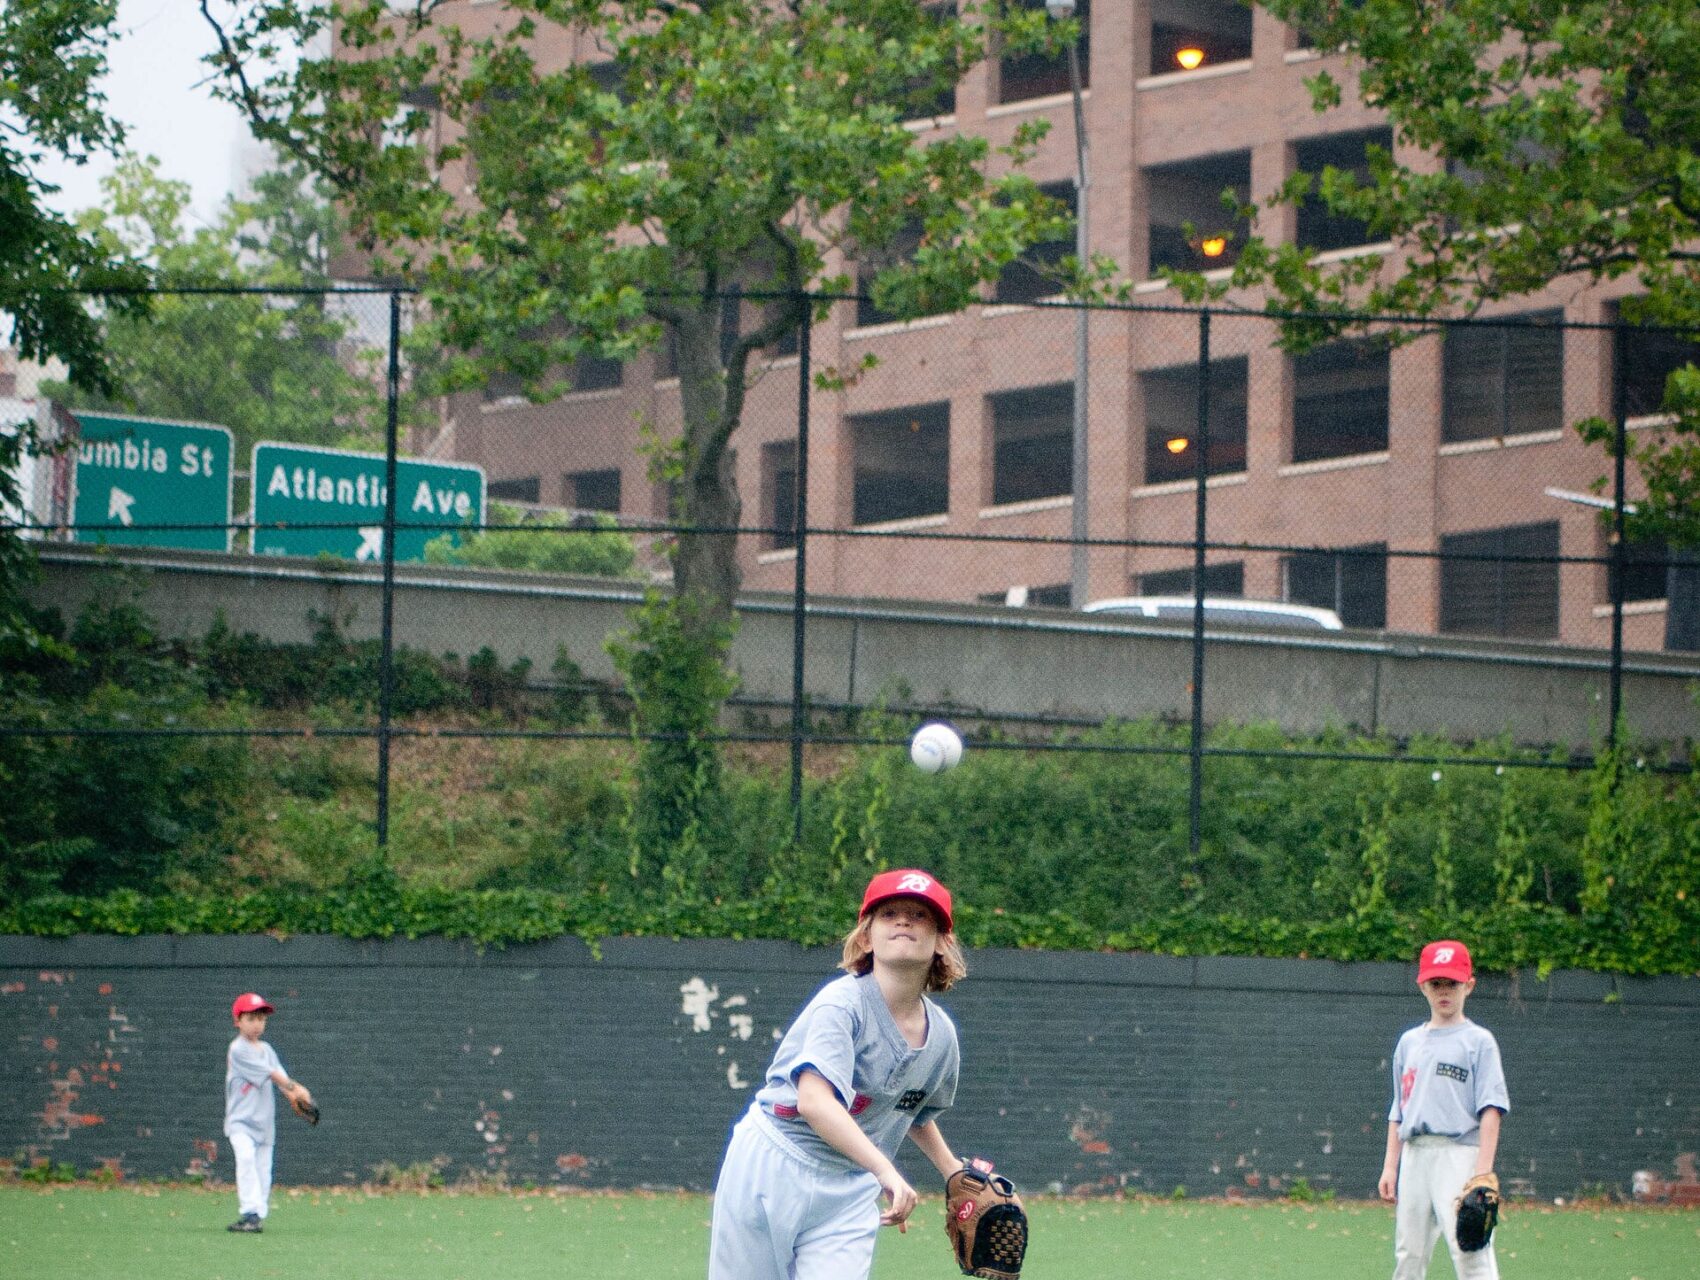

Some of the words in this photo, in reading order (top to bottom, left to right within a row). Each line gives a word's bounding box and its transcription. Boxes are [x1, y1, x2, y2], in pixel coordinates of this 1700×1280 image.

[78, 438, 168, 473] umbia
[180, 443, 214, 478] St
[411, 480, 472, 518] Ave
